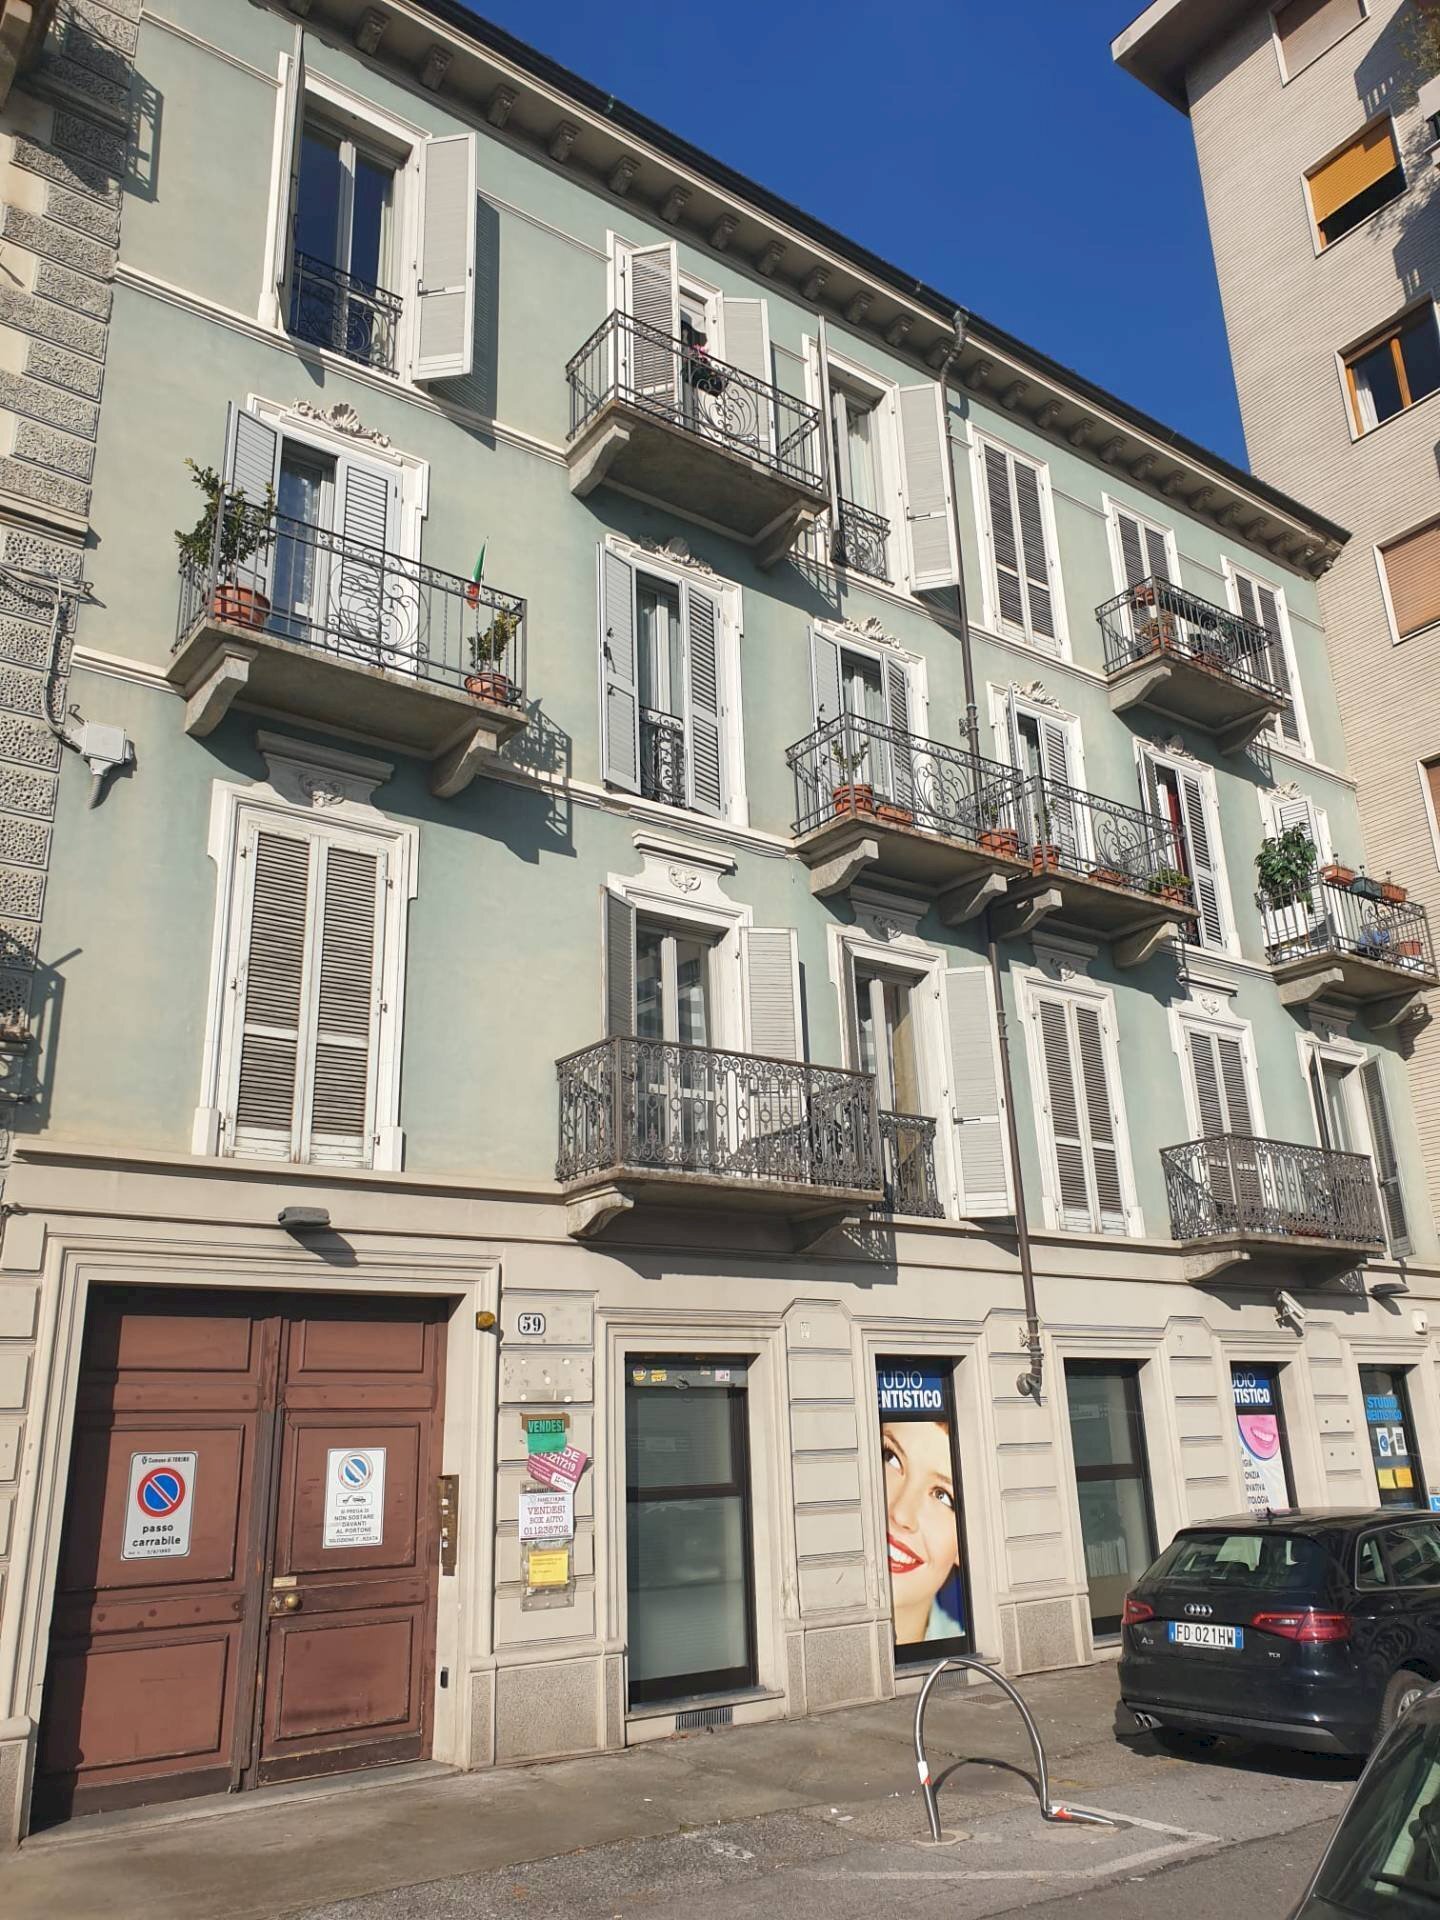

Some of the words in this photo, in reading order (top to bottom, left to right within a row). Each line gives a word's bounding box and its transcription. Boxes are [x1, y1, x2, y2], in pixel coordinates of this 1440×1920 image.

[523, 1316, 541, 1332] 59
[1367, 1396, 1397, 1409] STUDIO
[528, 1419, 565, 1433] VENDESI
[527, 1505, 566, 1515] VENDESI
[529, 1516, 544, 1524] BOX
[545, 1515, 564, 1523] AUTO
[143, 1524, 174, 1535] passo
[132, 1536, 181, 1547] carrabile
[1177, 1624, 1191, 1642] FD
[1196, 1626, 1235, 1648] 021HW
